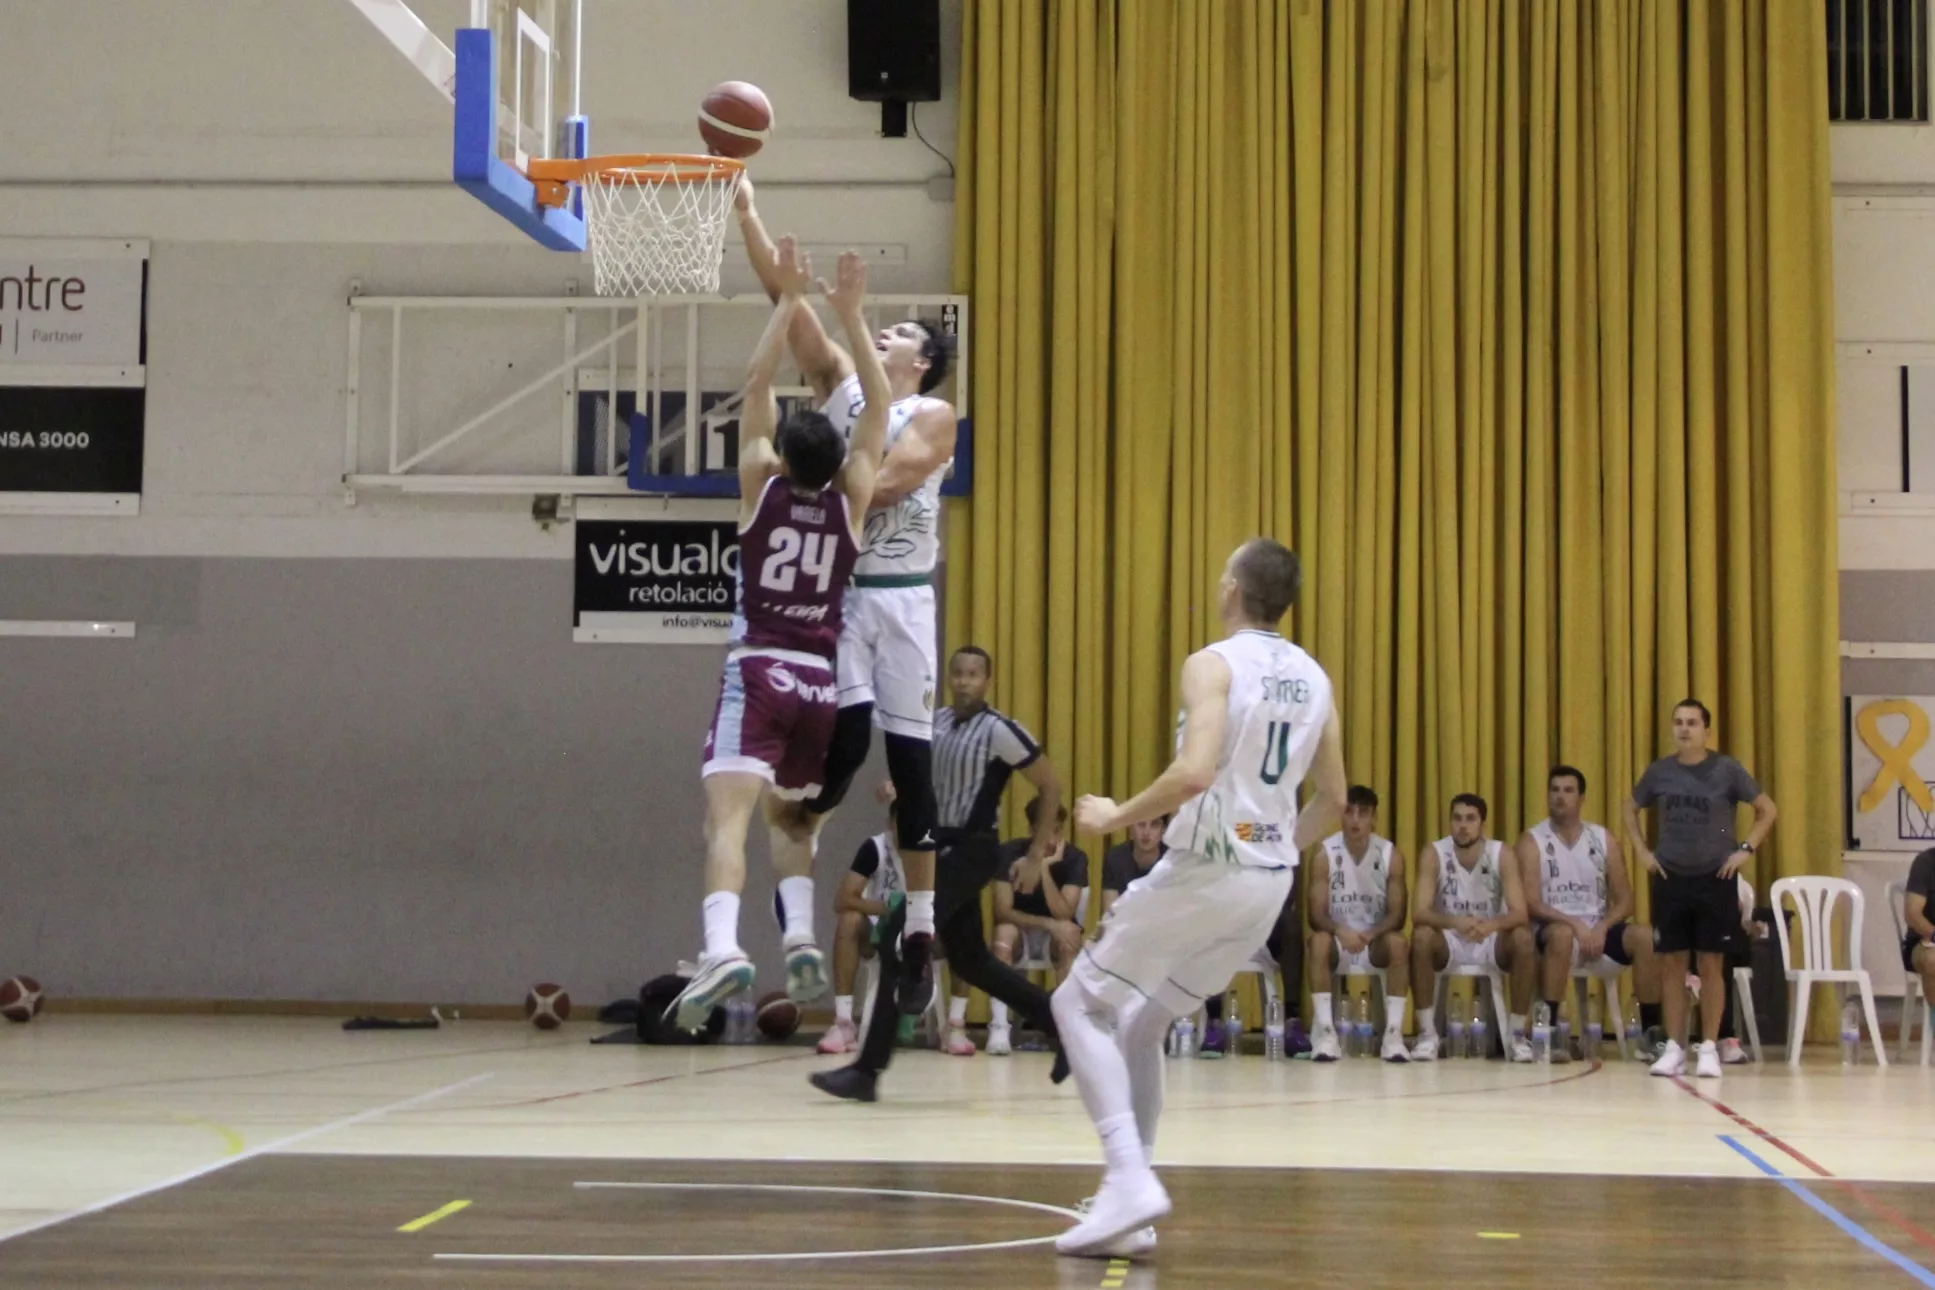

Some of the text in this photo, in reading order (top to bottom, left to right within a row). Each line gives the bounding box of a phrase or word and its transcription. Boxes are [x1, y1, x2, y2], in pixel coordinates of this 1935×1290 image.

[0, 264, 86, 311] ntre
[32, 328, 84, 342] Partner
[39, 431, 90, 448] 3000
[759, 526, 839, 594] 24
[628, 580, 729, 603] retolació
[1331, 869, 1345, 890] 24
